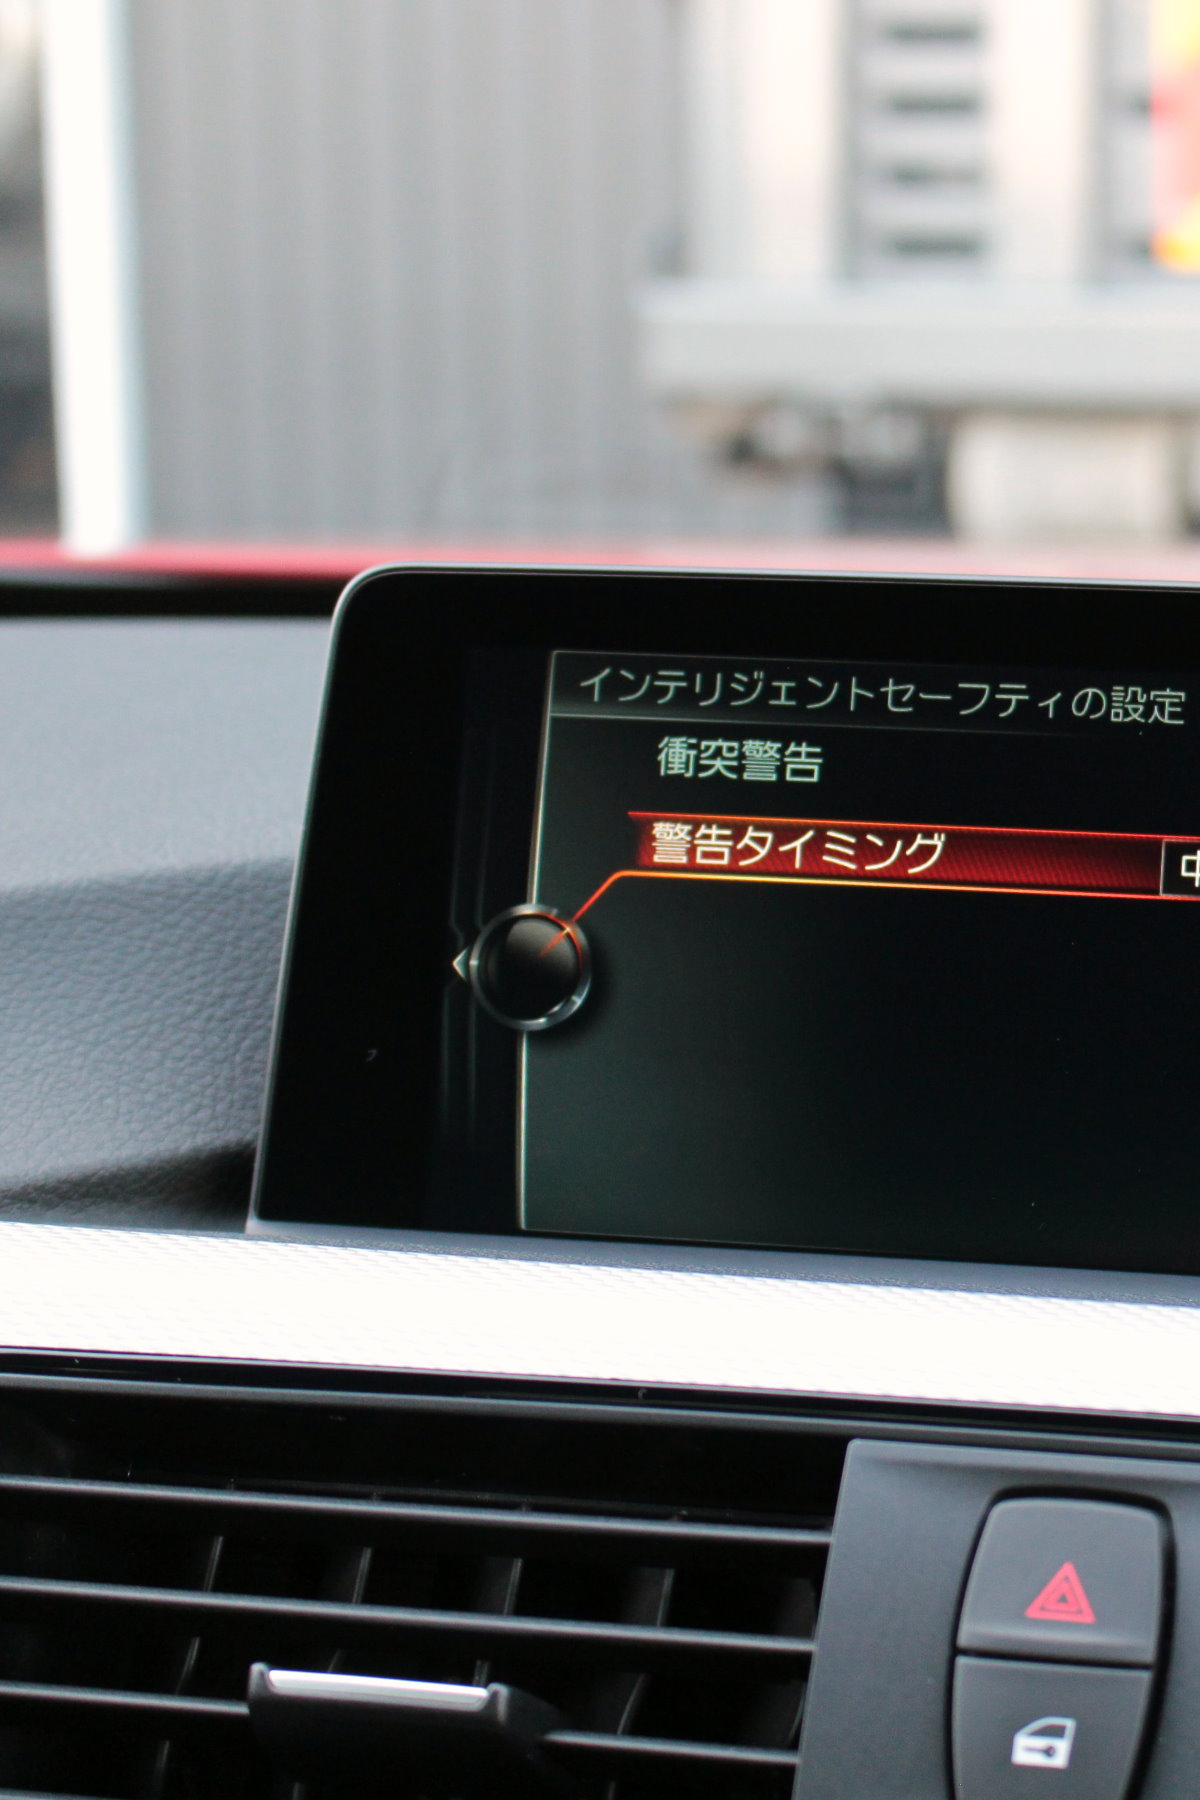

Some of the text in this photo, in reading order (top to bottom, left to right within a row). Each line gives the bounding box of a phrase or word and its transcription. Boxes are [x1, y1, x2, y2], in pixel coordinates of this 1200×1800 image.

[577, 667, 1187, 726] インテリジェントセーフティの設定
[656, 735, 824, 783] 衝突警告
[650, 821, 946, 874] 警告タイミング
